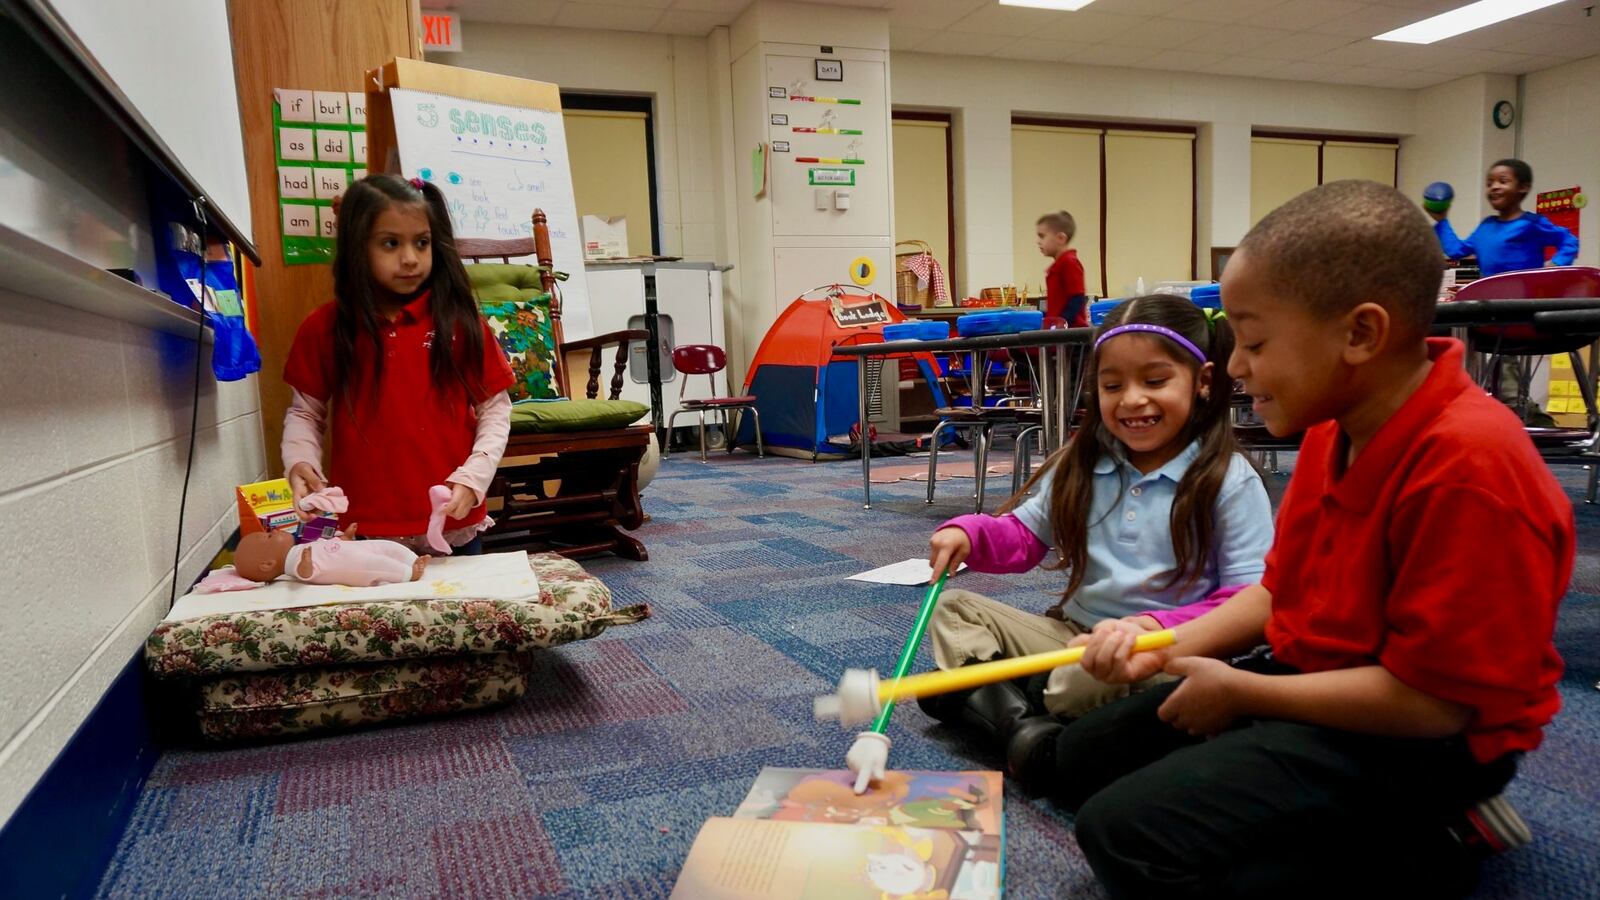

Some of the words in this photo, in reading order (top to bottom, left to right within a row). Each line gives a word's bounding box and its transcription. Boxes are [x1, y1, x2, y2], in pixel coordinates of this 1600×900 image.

[422, 15, 452, 45] XIT
[291, 98, 303, 112] if
[319, 100, 342, 115] but
[449, 107, 548, 145] senses
[289, 141, 305, 151] as
[324, 138, 343, 153] did
[284, 175, 308, 190] had
[322, 176, 340, 191] his
[290, 217, 310, 228] am
